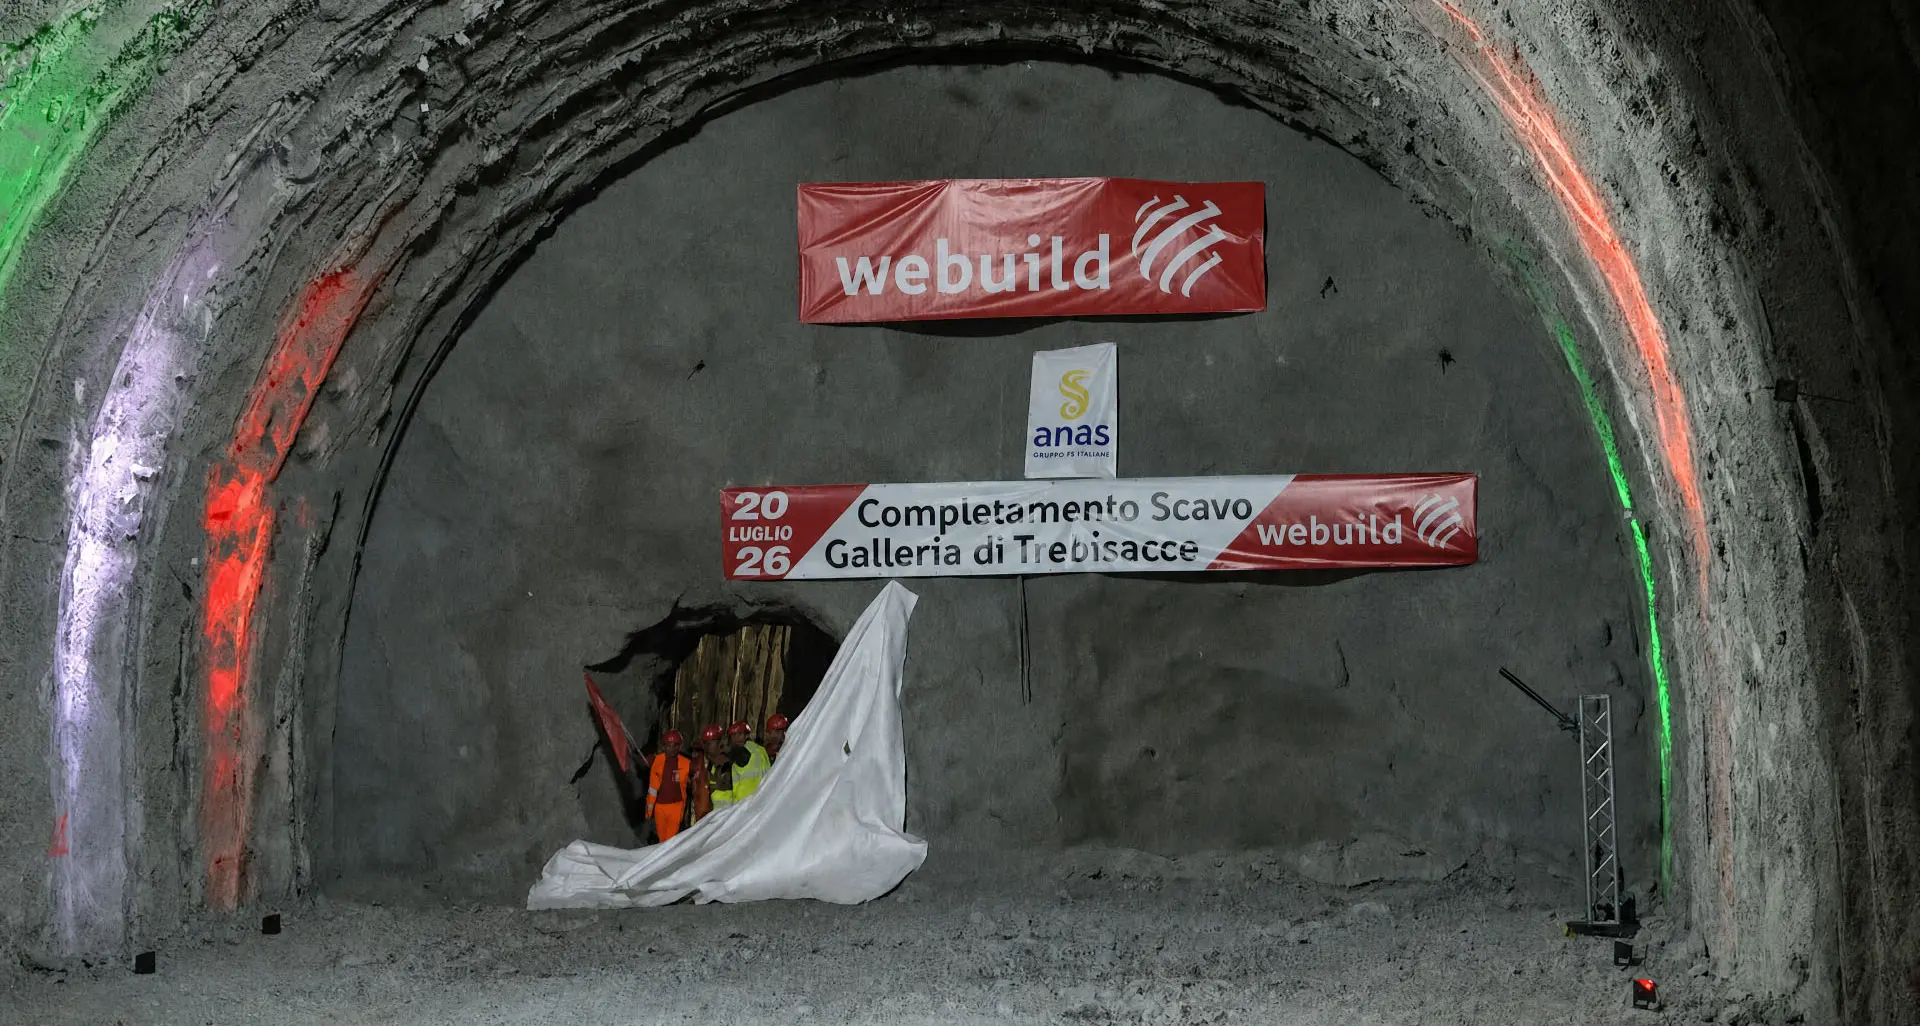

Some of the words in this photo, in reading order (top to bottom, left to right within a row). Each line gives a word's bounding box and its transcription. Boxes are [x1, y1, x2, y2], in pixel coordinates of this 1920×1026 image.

[836, 234, 1110, 296] webuild
[1033, 424, 1110, 447] anas
[731, 491, 789, 520] 20
[857, 495, 1139, 535] Completamento
[1151, 491, 1253, 521] Scavo
[729, 525, 793, 542] LUGLIO
[1257, 515, 1403, 546] webuild
[733, 546, 792, 576] 26
[825, 537, 961, 569] Galleria
[973, 535, 1005, 565] di
[1014, 531, 1199, 564] Trebisacce
